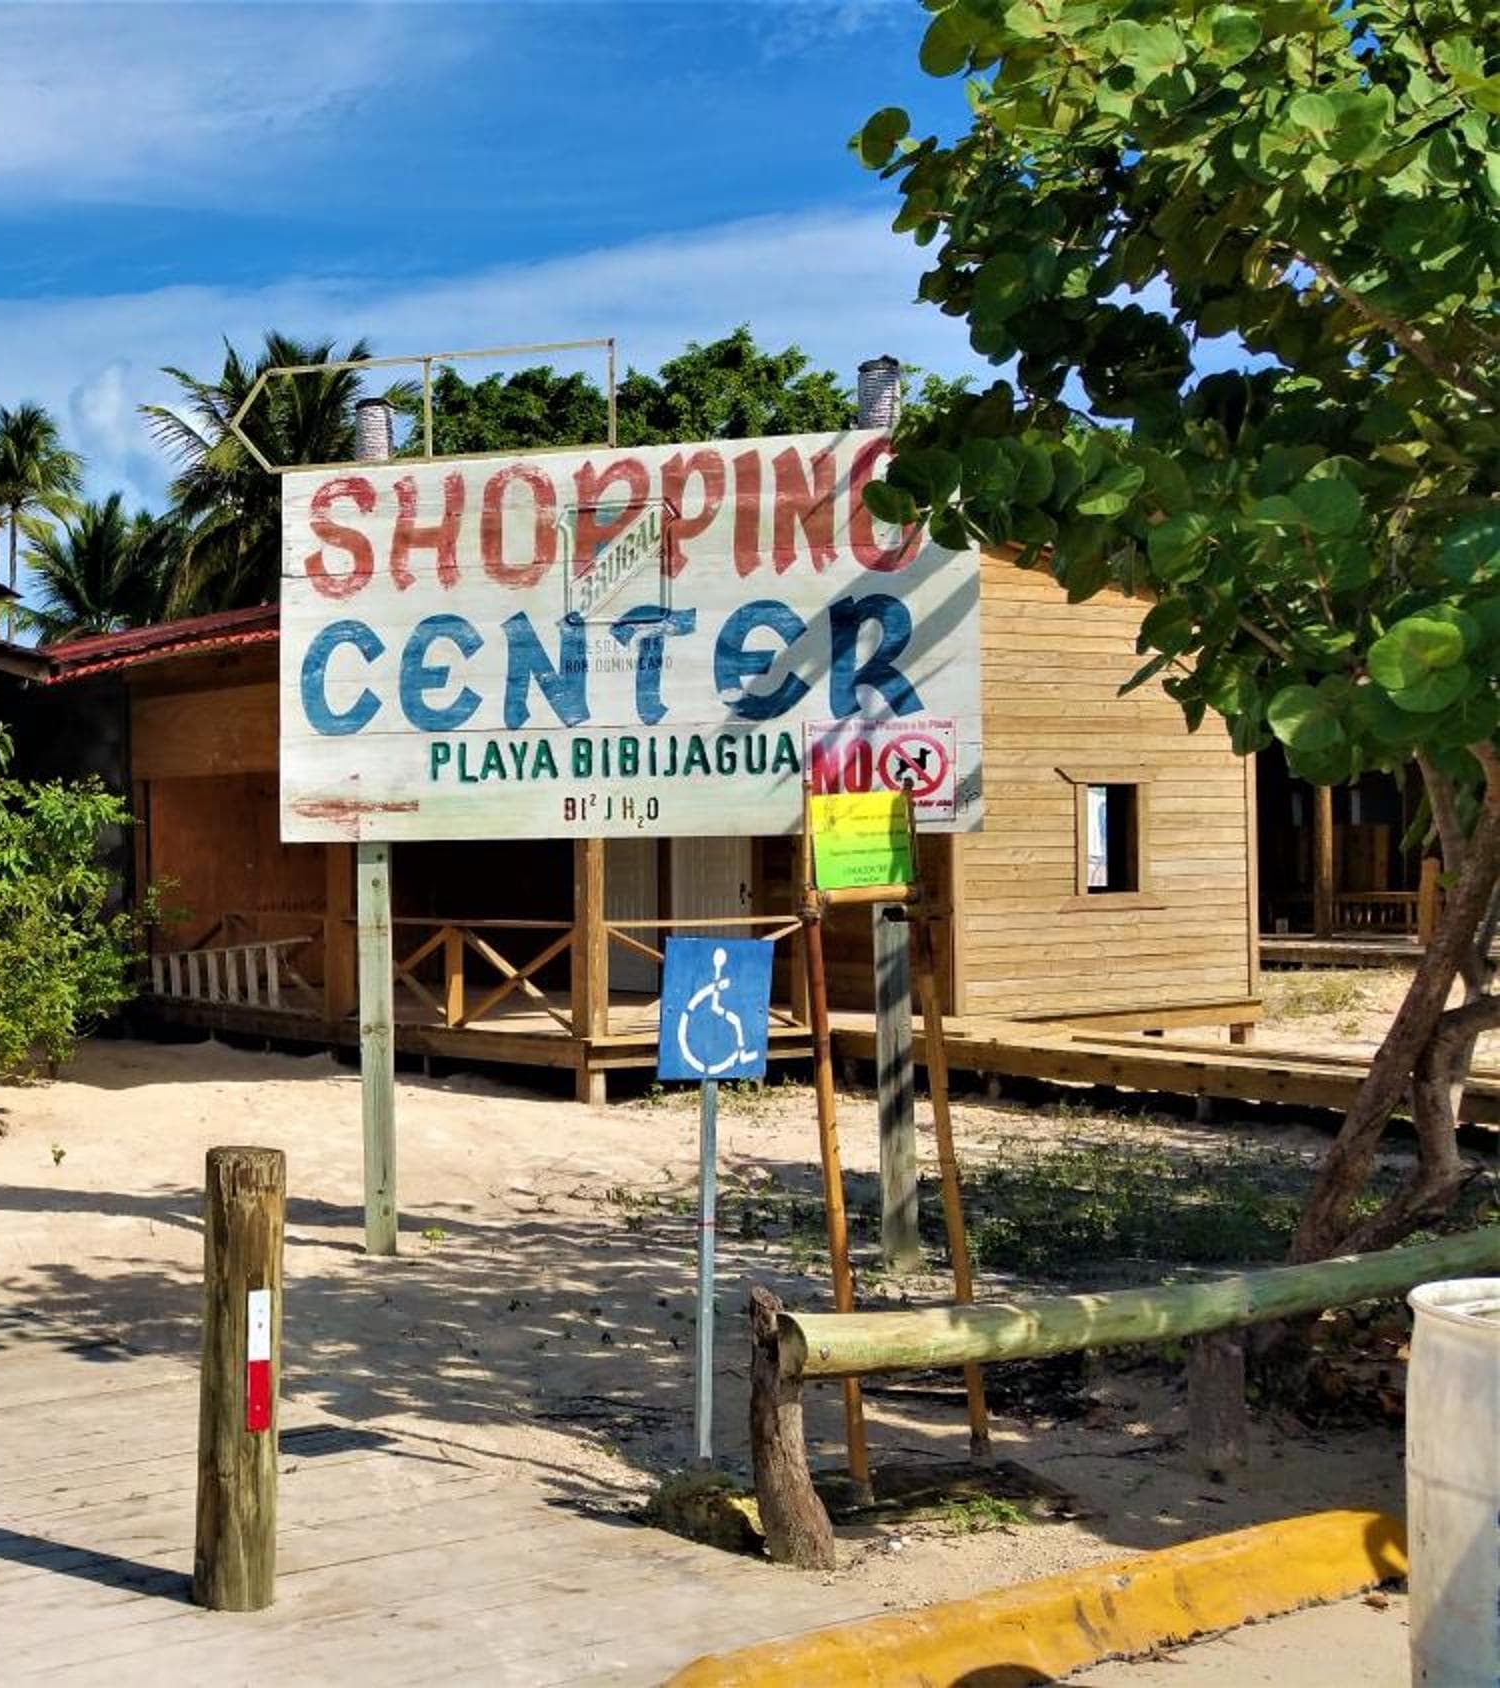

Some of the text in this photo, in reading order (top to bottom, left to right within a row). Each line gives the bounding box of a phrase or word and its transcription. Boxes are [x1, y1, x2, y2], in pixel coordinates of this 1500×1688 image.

[303, 438, 924, 601] SHOPPING
[300, 594, 925, 736] CENTER
[431, 732, 800, 783] PLAYA BIBIJAGUA
[811, 737, 873, 796] NO
